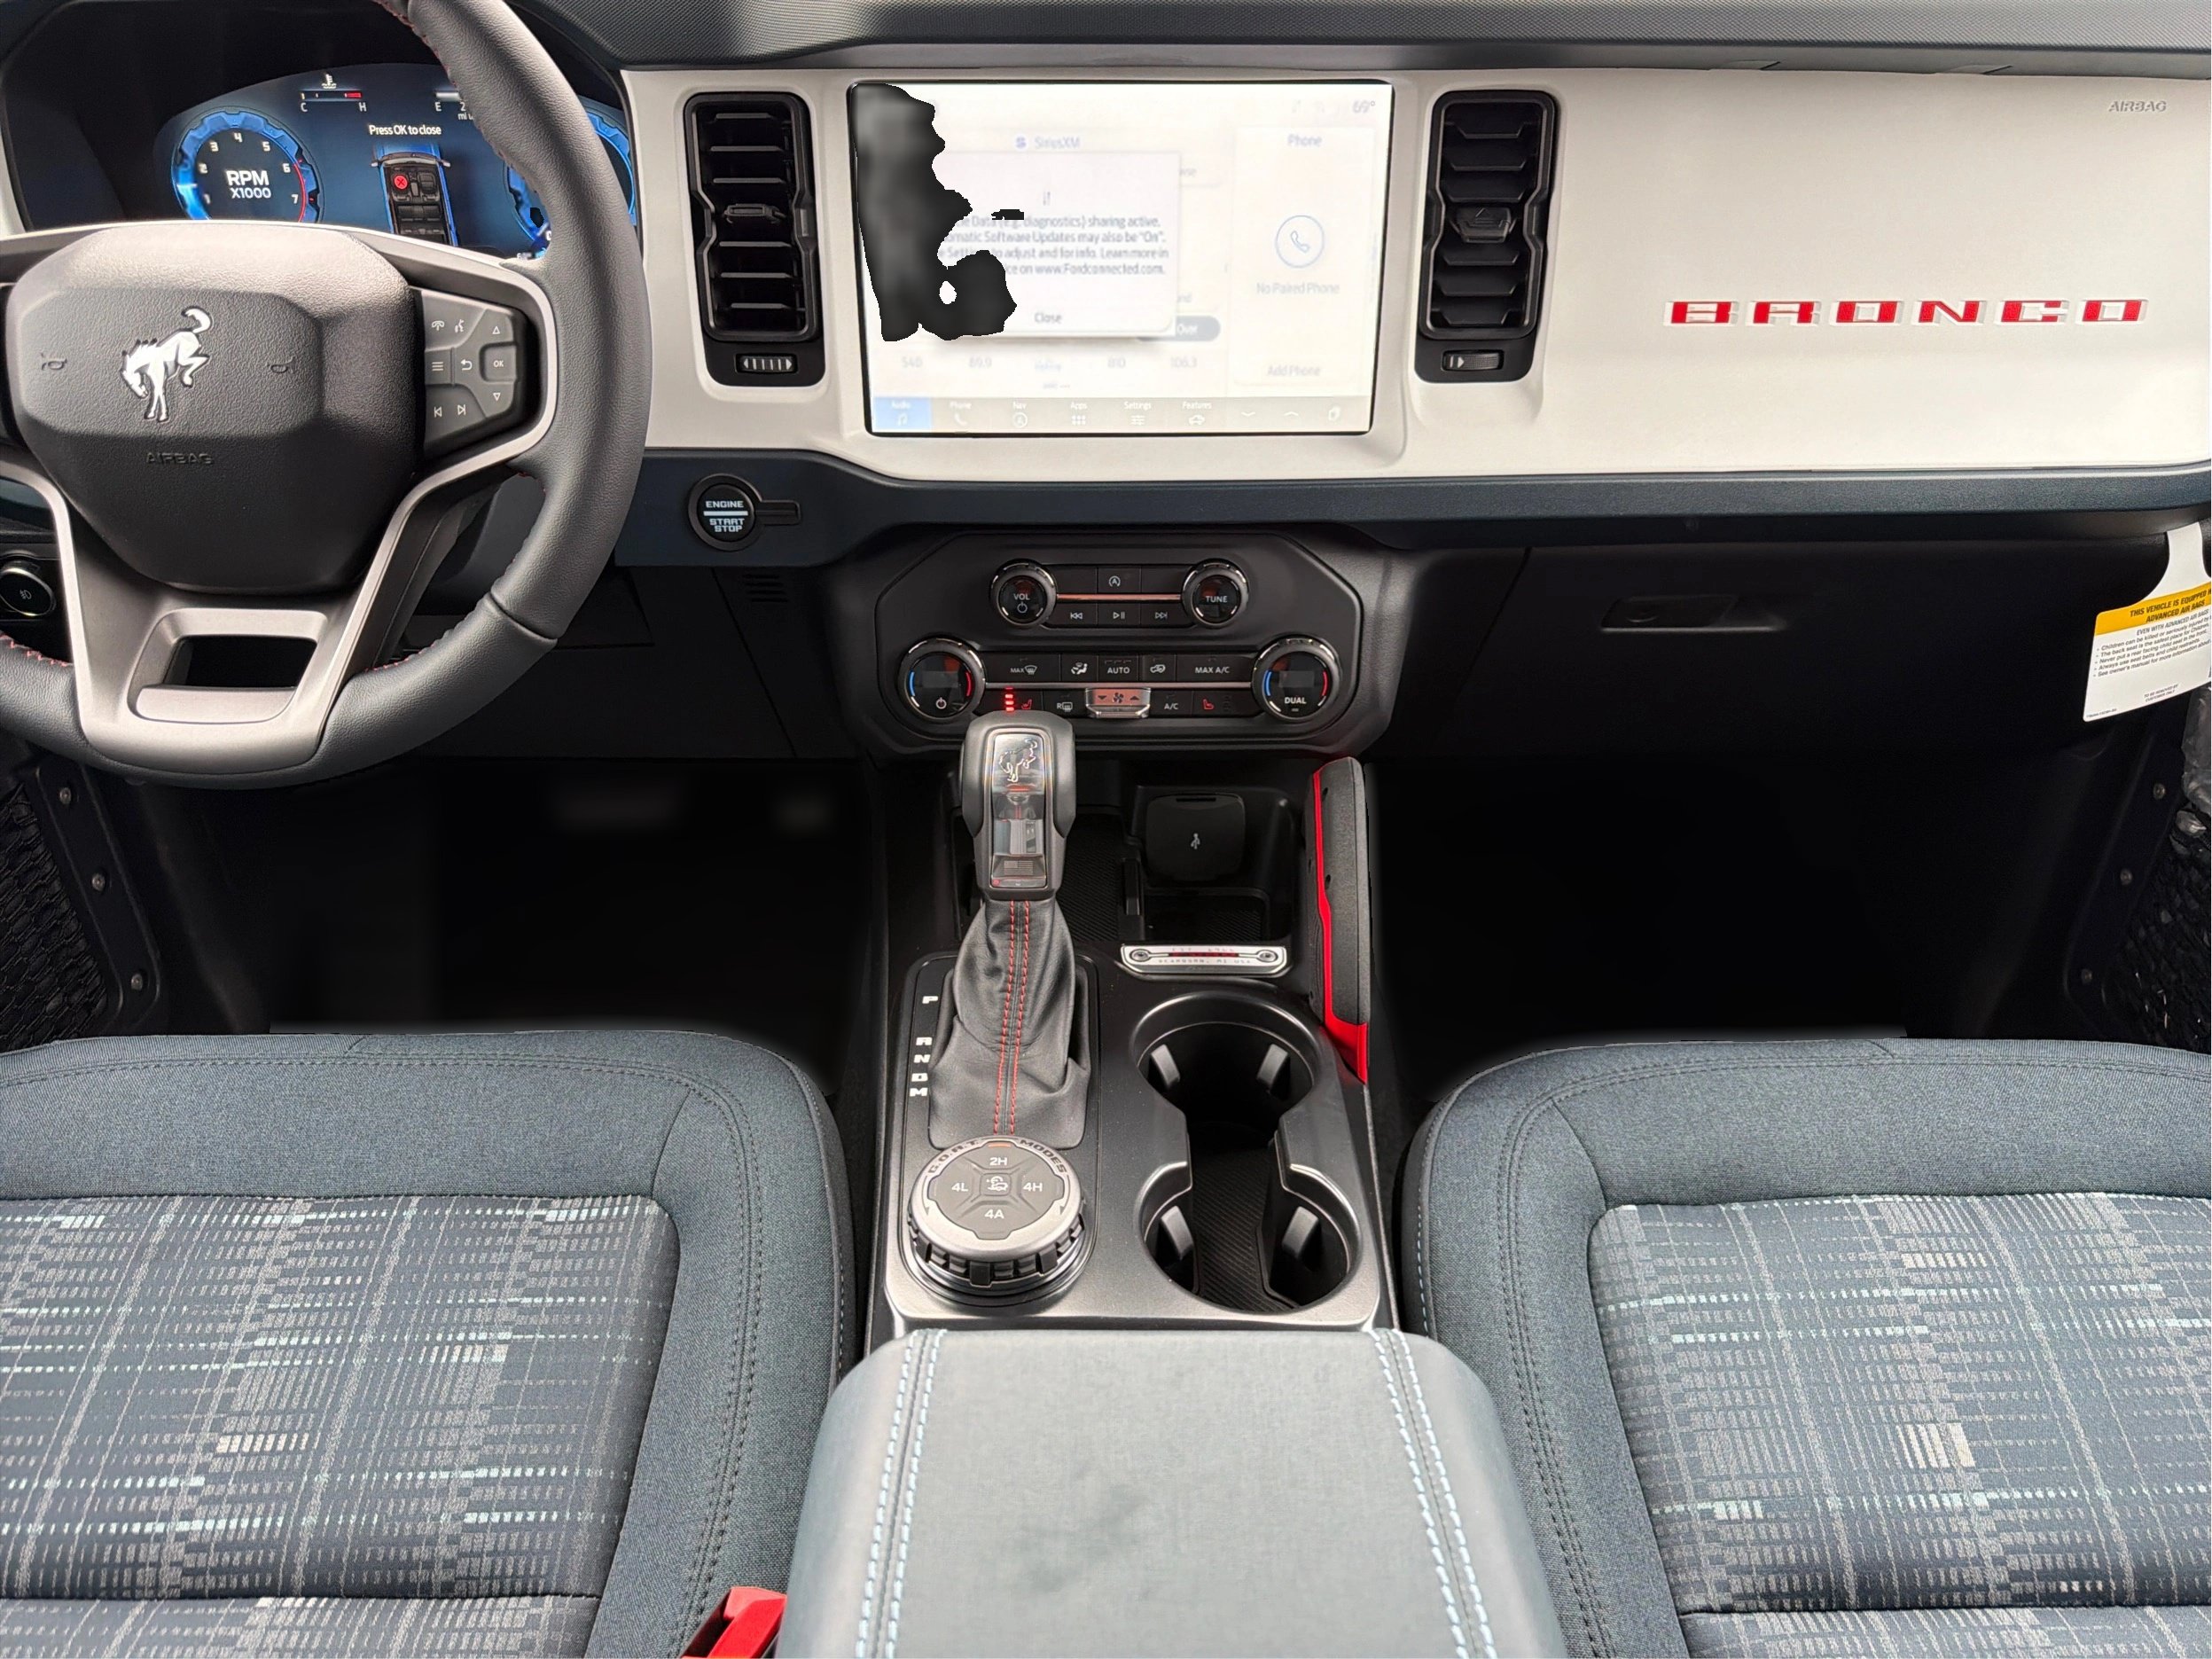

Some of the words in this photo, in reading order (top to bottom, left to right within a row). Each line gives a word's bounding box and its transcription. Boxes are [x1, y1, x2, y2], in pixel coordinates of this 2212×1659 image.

[301, 102, 308, 112] C
[359, 102, 367, 112] H
[434, 102, 442, 112] E
[2107, 100, 2168, 113] AIRBAG
[369, 125, 393, 137] Press
[394, 125, 408, 137] OK
[409, 126, 418, 137] to
[418, 125, 442, 137] close
[234, 133, 243, 143] 4
[1286, 133, 1323, 147] Phone
[210, 142, 219, 152] 3
[262, 142, 270, 152] 5
[199, 163, 207, 173] 2
[283, 163, 291, 173] 6
[226, 170, 270, 186] RPM
[231, 187, 271, 200] X1000
[291, 194, 299, 204] 7
[1087, 215, 1126, 230] sharing
[984, 231, 1030, 243] Software
[1031, 231, 1076, 245] Updates
[1077, 232, 1099, 245] may
[1101, 231, 1123, 243] also
[1124, 231, 1137, 243] be
[1004, 247, 1036, 260] adjust
[1038, 247, 1058, 258] and
[1059, 247, 1074, 258] for
[1019, 264, 1034, 275] on
[1256, 282, 1270, 294] No
[1271, 281, 1305, 294] Paired
[1306, 282, 1340, 294] Phone
[1667, 299, 2146, 325] BRONCO
[1034, 311, 1063, 326] Close
[493, 359, 504, 368] OK
[1267, 364, 1287, 376] Add
[1289, 364, 1321, 377] Phone
[1123, 401, 1152, 412] Settings
[1182, 401, 1213, 411] Features
[145, 451, 215, 466] AIRBAG
[705, 500, 745, 509] ENGINE
[2129, 607, 2145, 617] THIS
[2146, 600, 2172, 614] VEHICLE
[2172, 599, 2180, 607] IS
[2180, 590, 2208, 605] EQUIPPED
[2146, 608, 2180, 623] ADVANCED
[2180, 604, 2191, 614] AIR
[2191, 599, 2206, 611] BAGS
[2136, 627, 2151, 636] EVEN
[2151, 623, 2165, 632] WITH
[2164, 616, 2190, 628] ADVANCED
[2153, 636, 2169, 645] safest
[2169, 631, 2184, 640] place
[2101, 641, 2125, 651] Children
[2098, 661, 2118, 671] Always
[2166, 645, 2178, 653] child
[2130, 660, 2150, 669] manual
[1106, 666, 1130, 675] AUTO
[1194, 665, 1210, 675] MAX
[1211, 665, 1231, 675] A/C
[1284, 696, 1307, 705] DUAL
[1163, 701, 1179, 711] A/C
[916, 1037, 933, 1045] R
[913, 1054, 931, 1063] N
[911, 1073, 928, 1082] D
[910, 1087, 928, 1097] M
[989, 1156, 1008, 1166] 2H
[1019, 1139, 1067, 1173] MODES
[951, 1182, 969, 1192] 4L
[1022, 1182, 1043, 1192] 4H
[984, 1209, 1004, 1219] 4A
